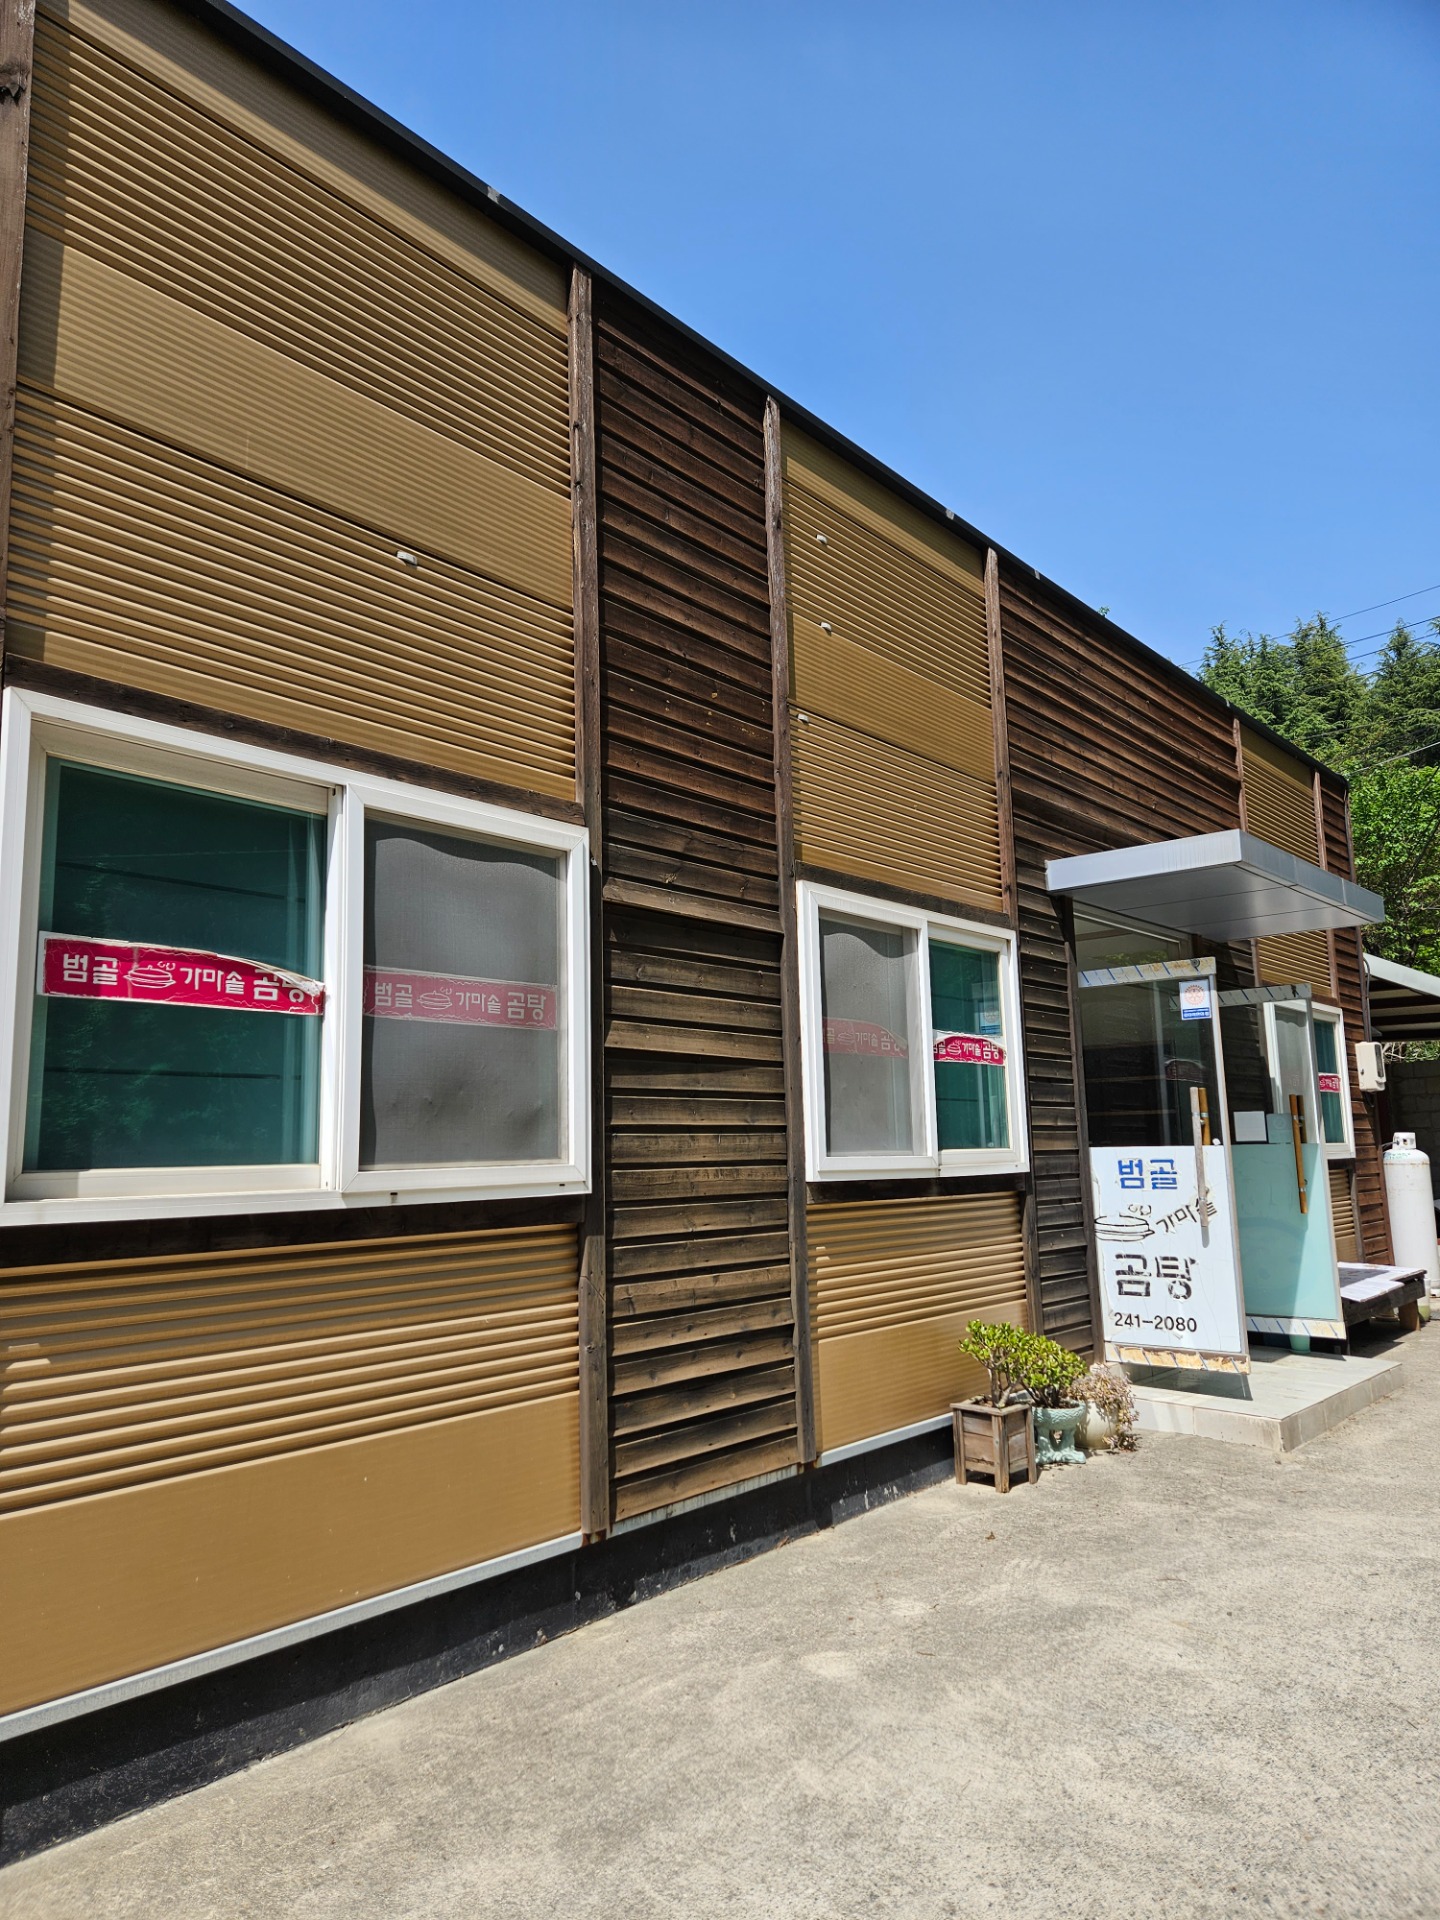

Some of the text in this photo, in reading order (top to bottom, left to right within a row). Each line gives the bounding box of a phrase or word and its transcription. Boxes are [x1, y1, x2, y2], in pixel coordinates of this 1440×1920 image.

[63, 953, 119, 985] 범골
[180, 967, 245, 995] 가마솥
[375, 981, 546, 1020] 범골 가마솥 곰탕
[1117, 1158, 1178, 1190] 범골
[1115, 1253, 1197, 1300] 곰탕
[1114, 1312, 1198, 1333] 241-2080
